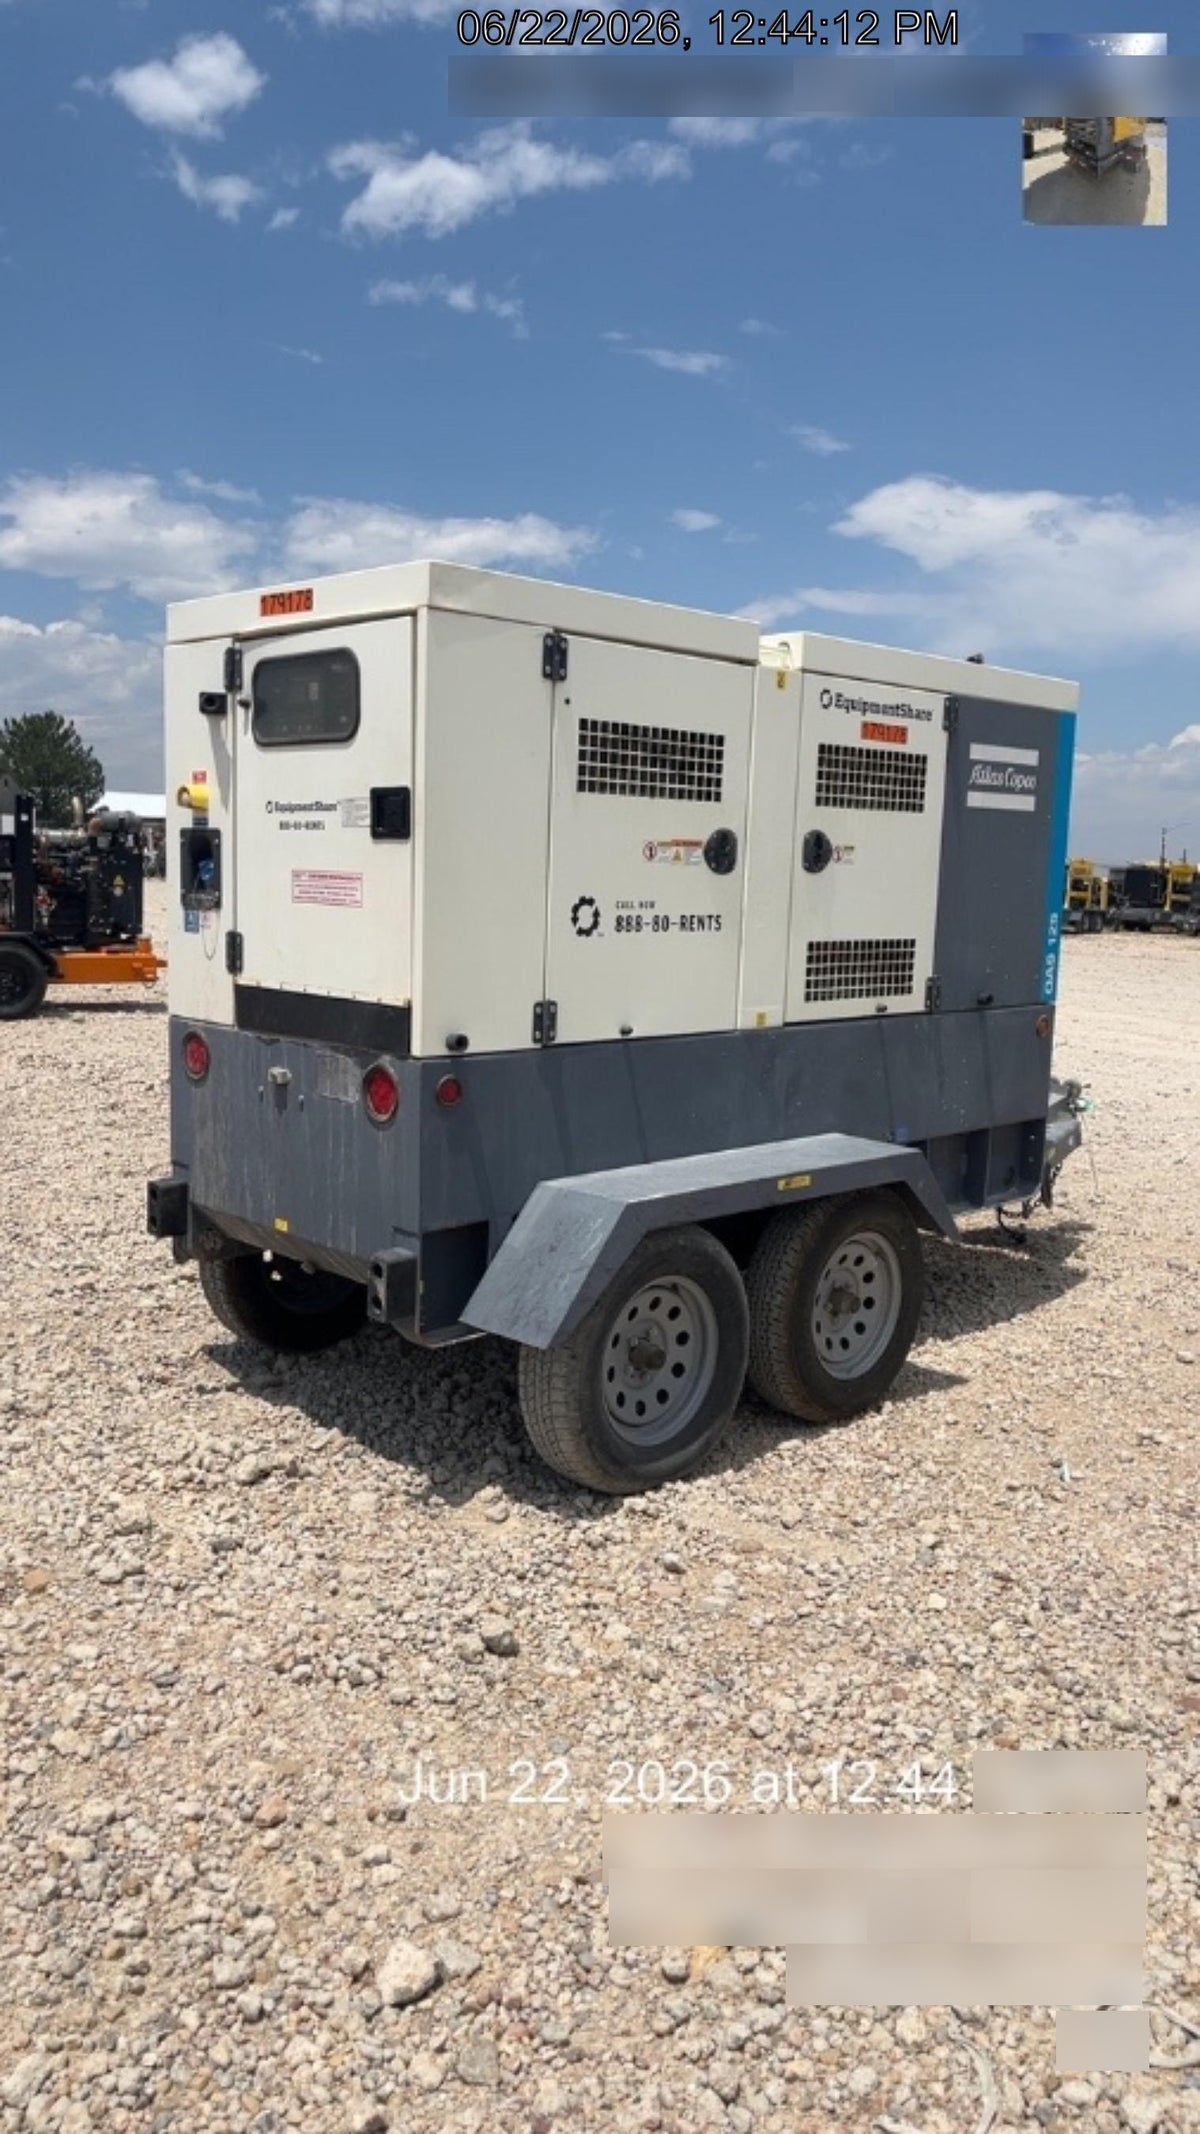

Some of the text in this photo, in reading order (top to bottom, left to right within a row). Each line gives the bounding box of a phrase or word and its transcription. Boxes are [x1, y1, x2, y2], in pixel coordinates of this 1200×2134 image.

[835, 692, 933, 721] EquipmentShare
[969, 764, 1037, 792] Atlas Copco
[615, 914, 723, 933] 888-80-RENTS
